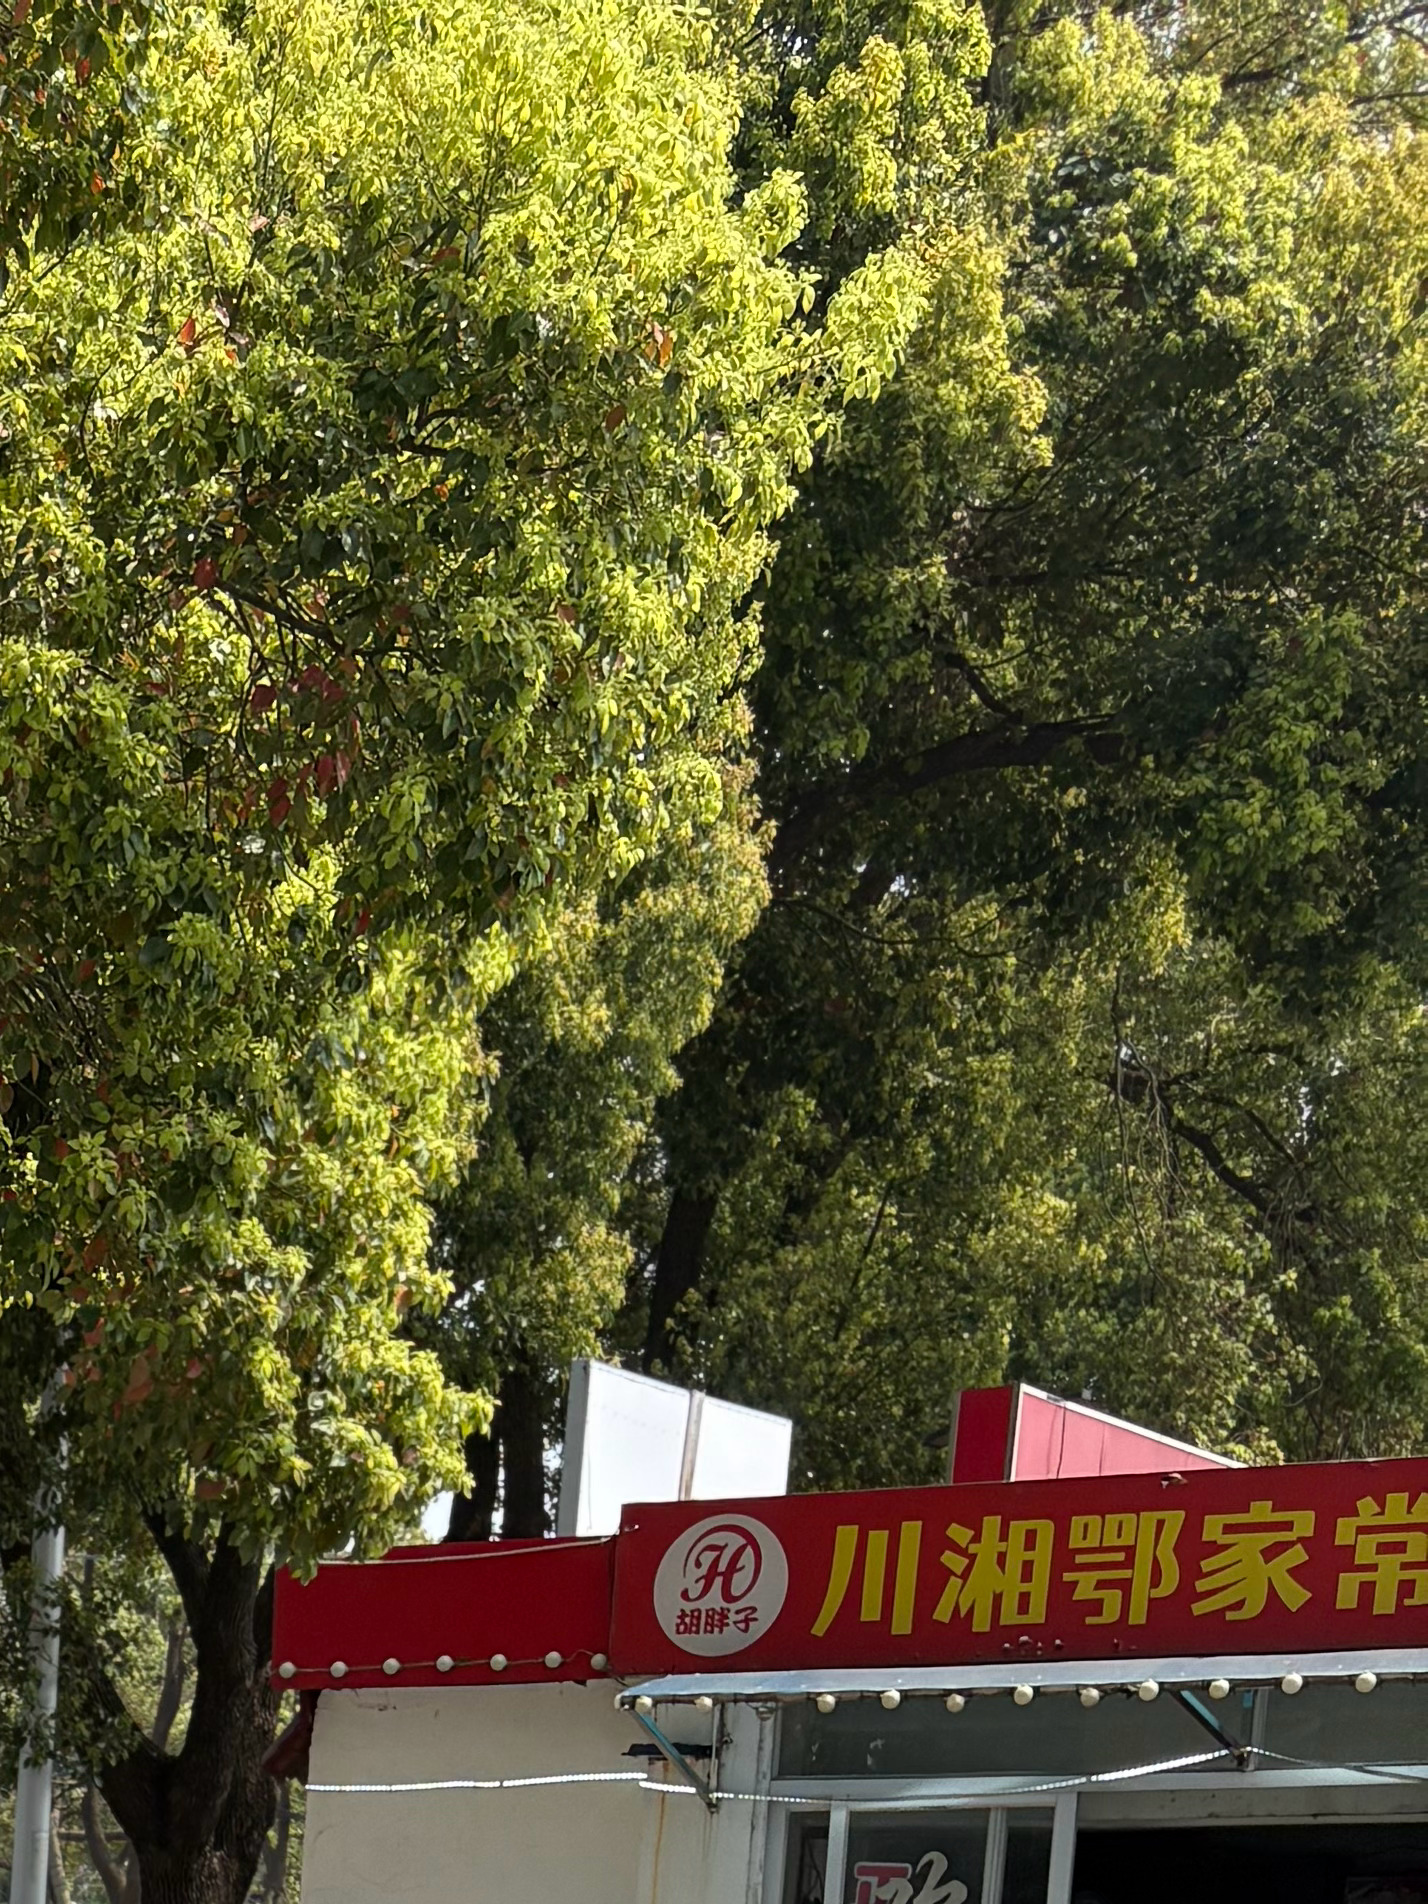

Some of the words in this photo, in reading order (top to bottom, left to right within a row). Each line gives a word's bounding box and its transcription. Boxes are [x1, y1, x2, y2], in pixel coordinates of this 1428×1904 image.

[810, 1491, 1428, 1638] 川湘鄂家常
[674, 1605, 760, 1639] 胡胖子
